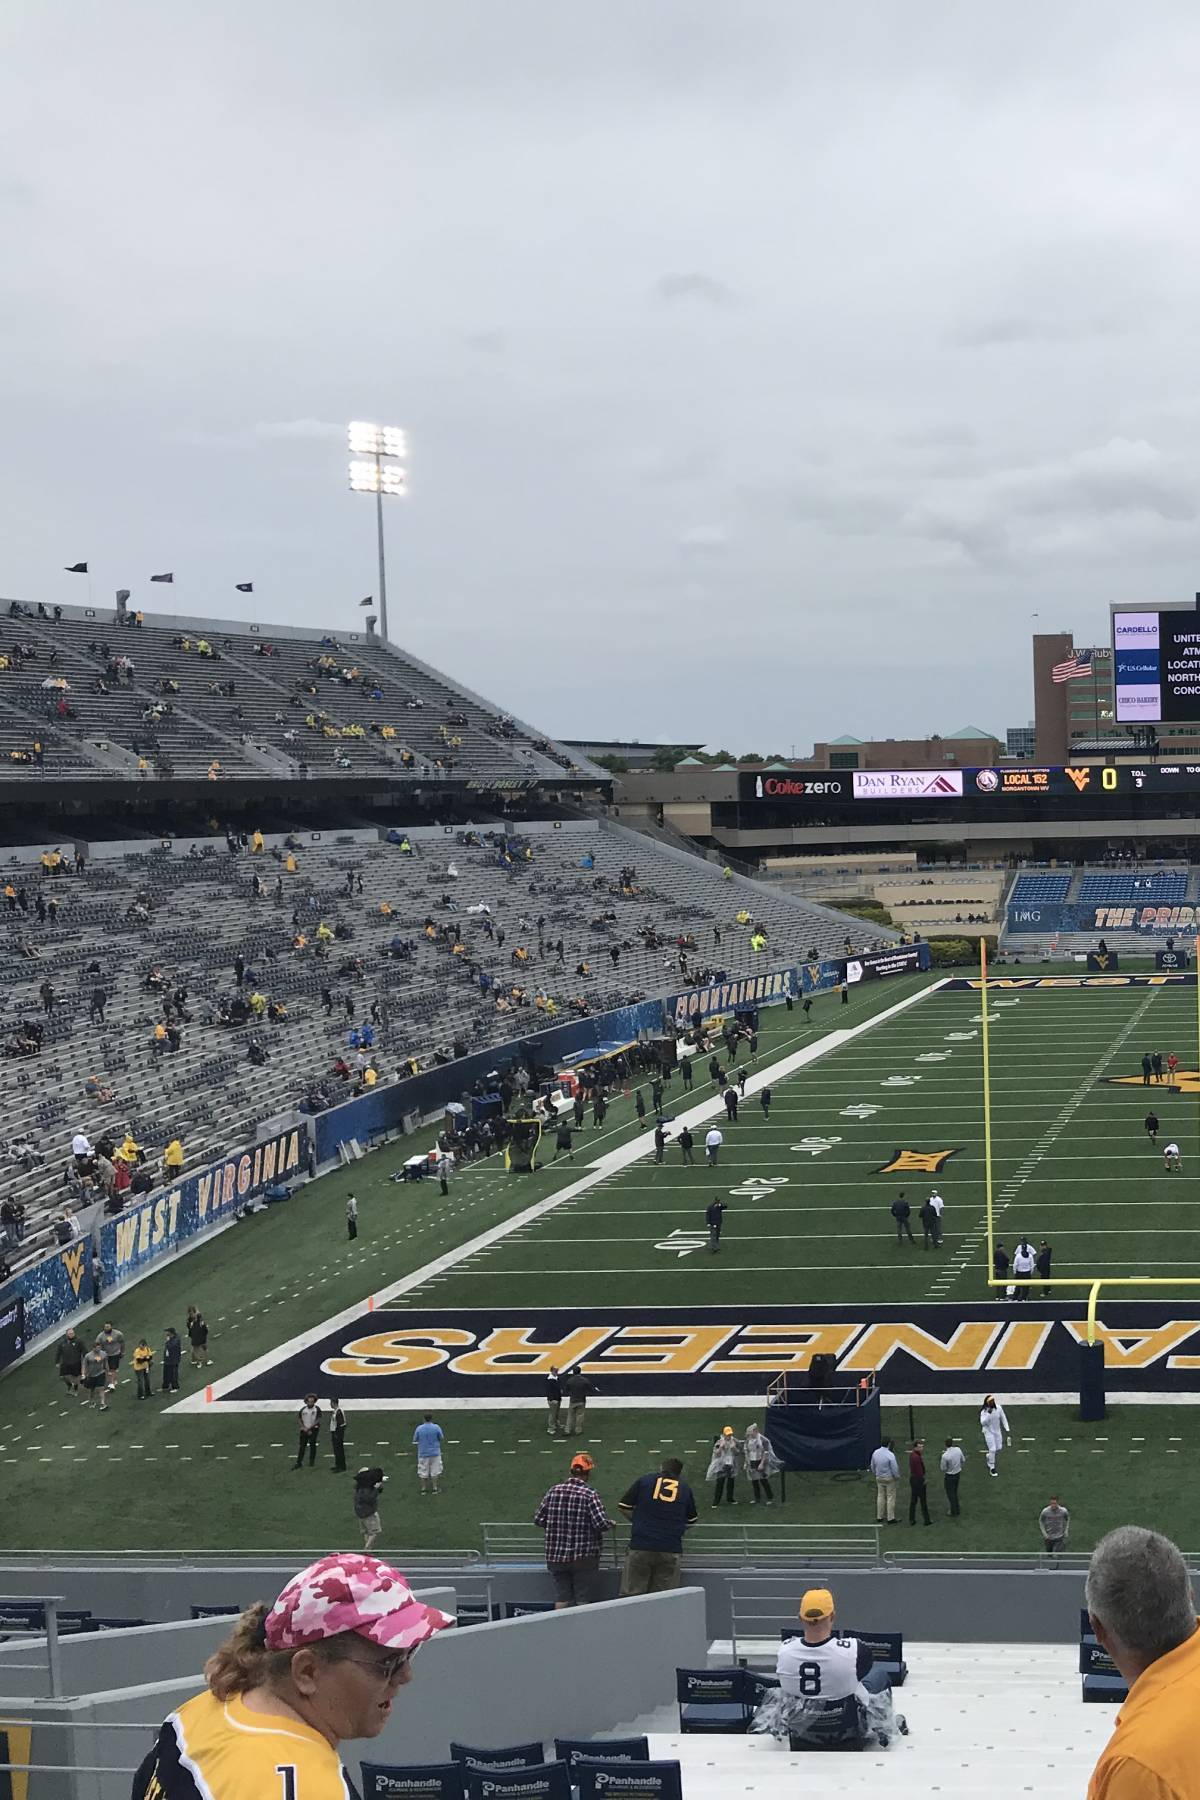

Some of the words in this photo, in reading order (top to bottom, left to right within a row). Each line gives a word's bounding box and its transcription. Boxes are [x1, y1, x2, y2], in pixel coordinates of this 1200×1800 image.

[765, 778, 804, 794] Coke
[804, 779, 841, 794] zero
[857, 775, 885, 787] DAN
[890, 774, 925, 786] RYAN
[1004, 774, 1031, 785] LOCAL
[1031, 773, 1048, 784] 152
[1102, 768, 1117, 790] 0
[1135, 778, 1143, 788] 3
[1014, 910, 1041, 922] IMG
[1094, 907, 1136, 927] THE
[966, 976, 1185, 989] WEST
[675, 971, 791, 1018] MOUNTAINEERS
[790, 1135, 843, 1151] 30
[729, 1176, 790, 1196] 20
[115, 1190, 181, 1267] WEST
[197, 1131, 300, 1217] VIRGINIA
[653, 1228, 712, 1251] 10
[652, 1477, 679, 1503] 13
[799, 1661, 822, 1696] 8
[275, 1764, 298, 1800] 1
[388, 1779, 442, 1788] Panhandle
[495, 1780, 550, 1793] Panhandle
[609, 1776, 662, 1785] Panhandle
